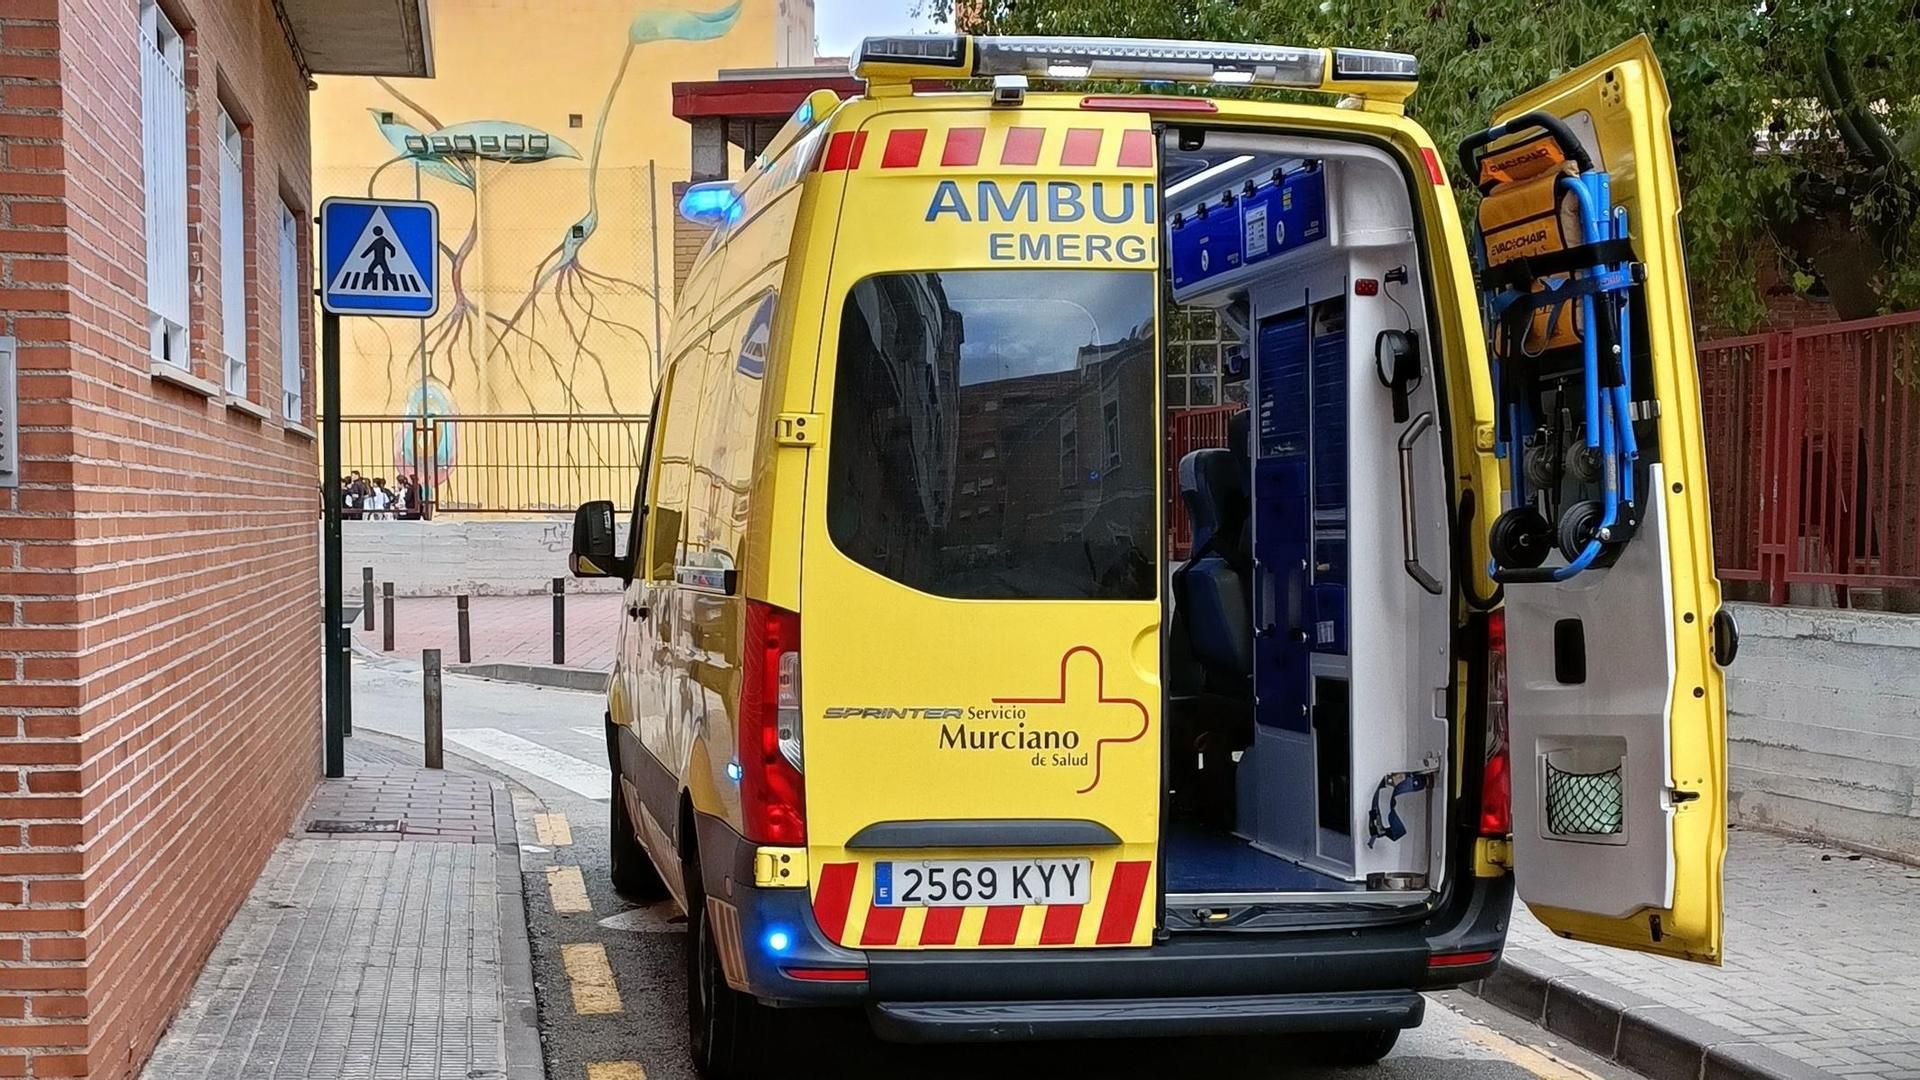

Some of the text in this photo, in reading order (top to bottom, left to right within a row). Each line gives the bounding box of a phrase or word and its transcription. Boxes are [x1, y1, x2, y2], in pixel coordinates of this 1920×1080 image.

[990, 233, 1156, 263] EMERG
[823, 707, 964, 720] SPRINTER
[968, 705, 1026, 719] Servicio
[939, 722, 1079, 749] Murciano
[1031, 753, 1088, 766] de Salud
[902, 863, 1080, 902] 2569 KYY
[879, 888, 888, 898] E
